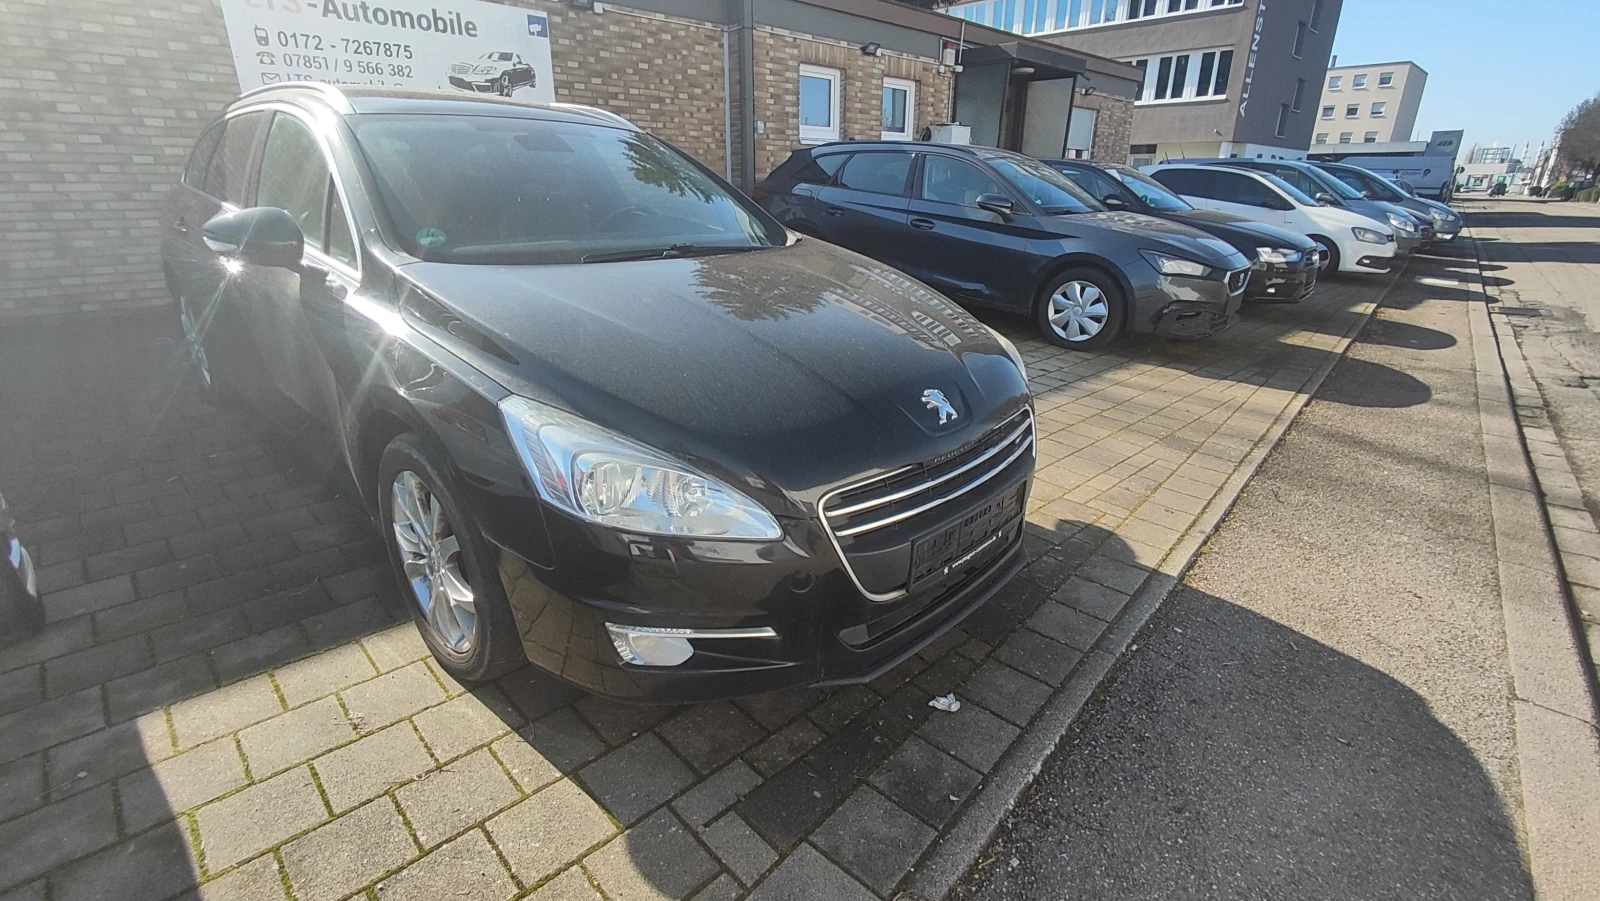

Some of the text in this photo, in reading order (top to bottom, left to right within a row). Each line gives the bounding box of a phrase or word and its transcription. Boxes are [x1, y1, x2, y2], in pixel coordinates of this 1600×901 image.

[277, 30, 324, 51] 0172
[340, 37, 413, 60] 7267875
[282, 52, 330, 71] 07851
[343, 59, 353, 73] 9
[357, 61, 384, 76] 566
[388, 63, 414, 78] 382
